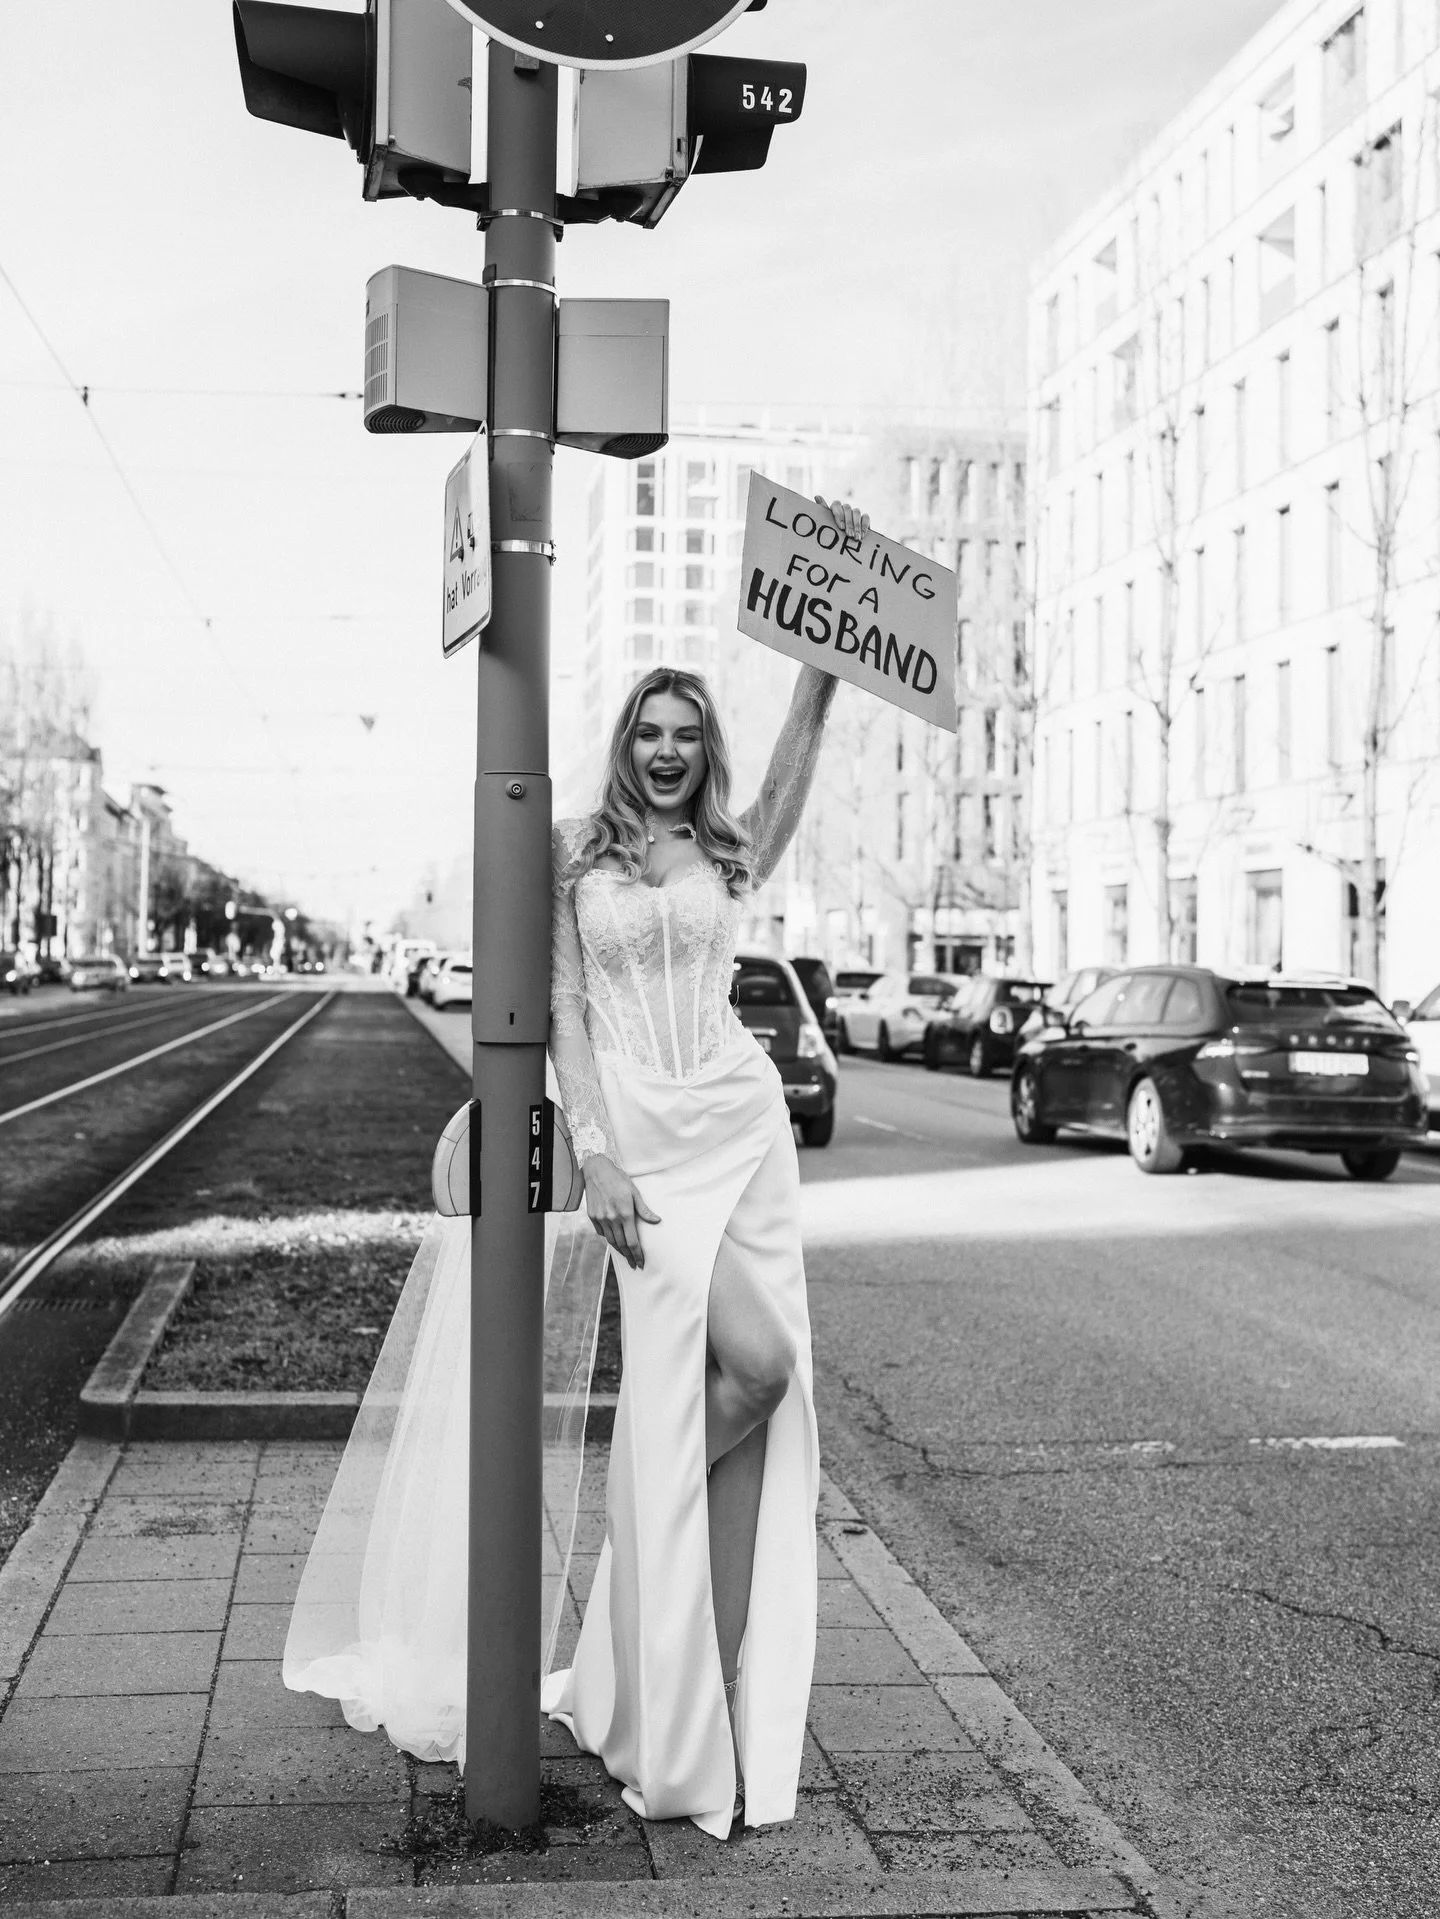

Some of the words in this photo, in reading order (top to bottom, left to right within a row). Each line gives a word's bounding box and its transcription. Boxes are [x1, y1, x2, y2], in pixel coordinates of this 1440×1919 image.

[742, 84, 793, 114] 542
[446, 581, 458, 614] hat
[858, 587, 878, 614] A
[747, 567, 938, 695] HUSBAND
